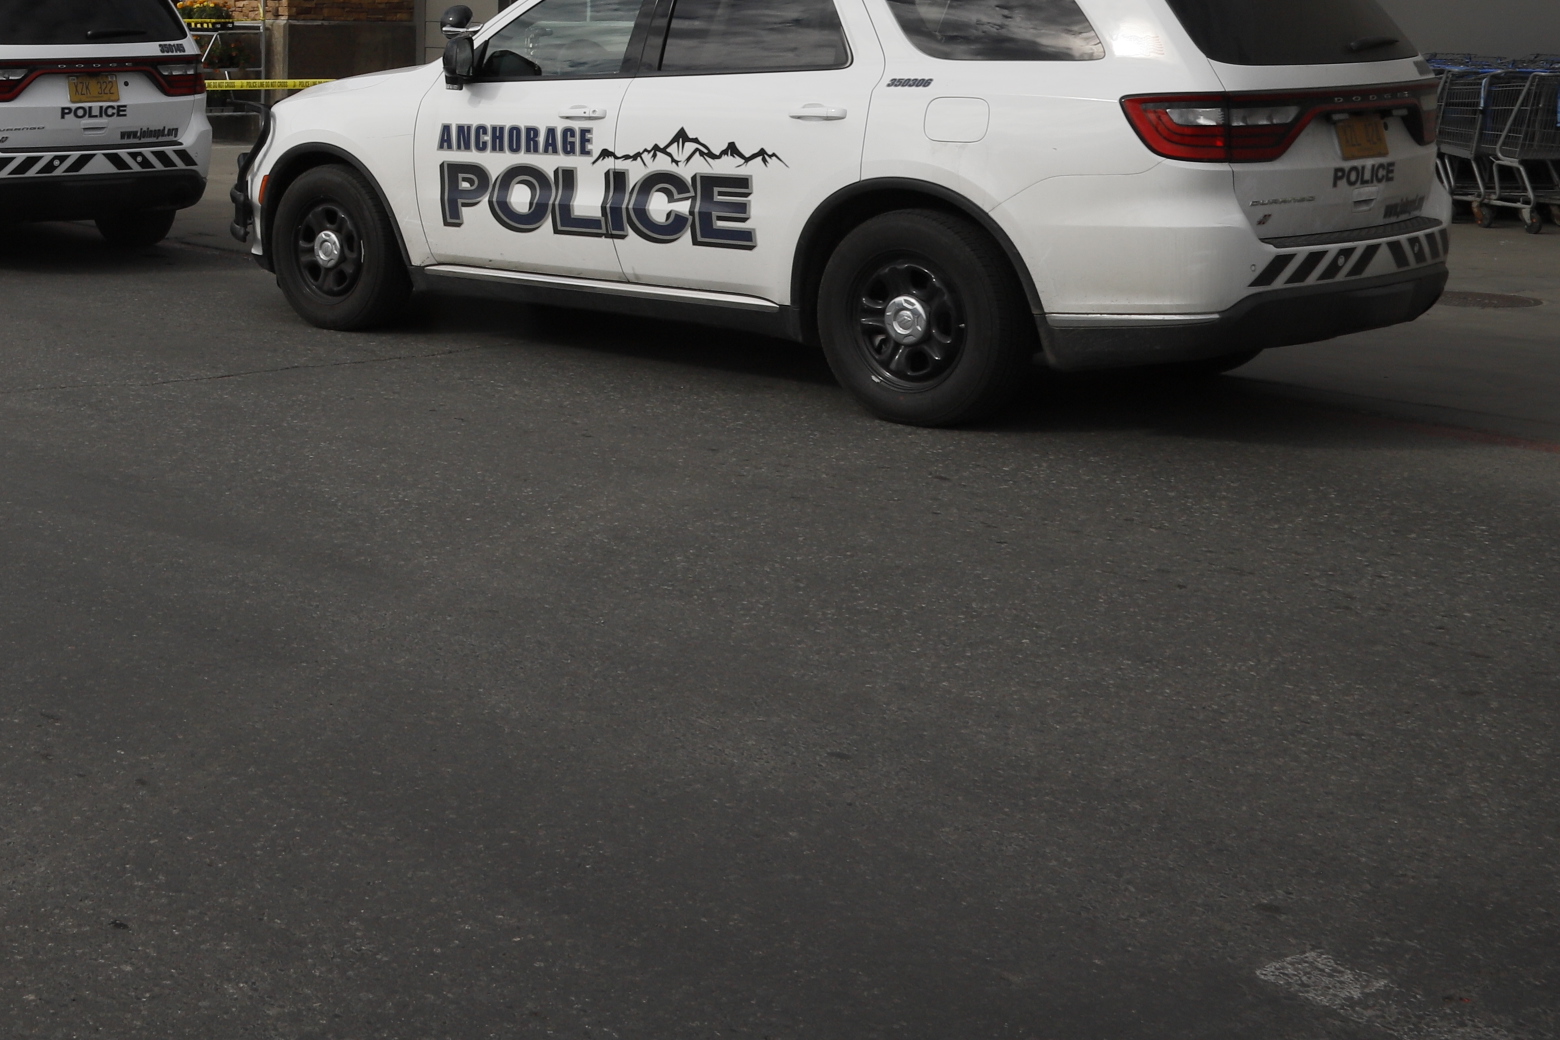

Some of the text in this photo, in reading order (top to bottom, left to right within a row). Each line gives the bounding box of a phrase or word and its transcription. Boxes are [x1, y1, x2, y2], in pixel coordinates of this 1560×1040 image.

[73, 80, 115, 96] XZK 322
[886, 77, 934, 88] 350306
[60, 105, 128, 120] POLICE
[436, 122, 594, 157] ANCHORAGE
[1332, 162, 1395, 188] POLICE
[439, 160, 758, 250] POLICE
